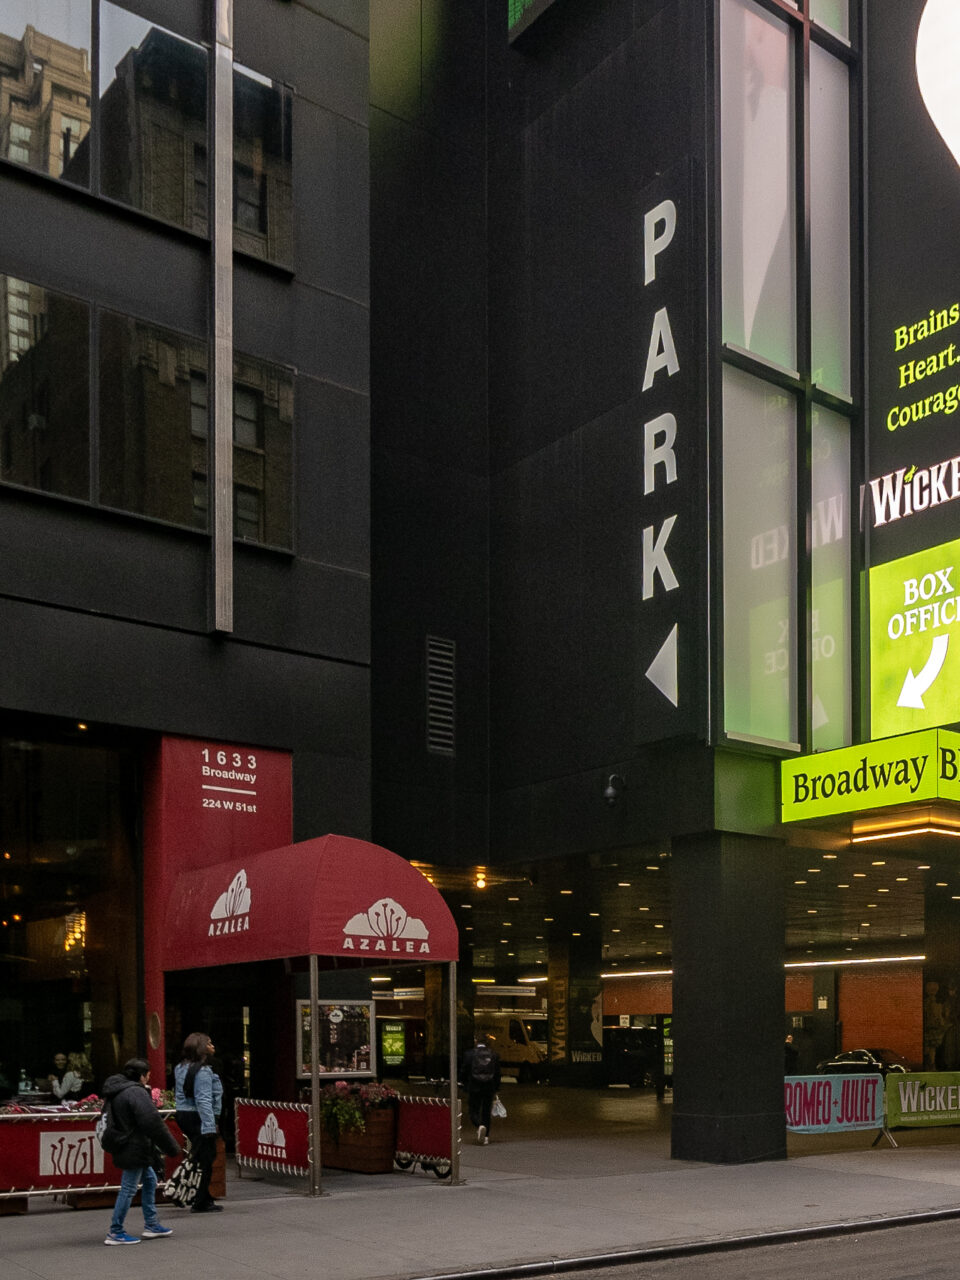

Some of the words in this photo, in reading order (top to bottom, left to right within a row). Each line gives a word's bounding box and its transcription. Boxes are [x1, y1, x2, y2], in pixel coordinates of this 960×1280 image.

[642, 198, 681, 601] PARK
[903, 566, 955, 607] BOX
[202, 748, 257, 769] 1633
[202, 765, 257, 784] Broadway
[792, 755, 929, 804] Broadway
[202, 798, 221, 809] 224
[223, 800, 234, 810] W
[235, 801, 257, 813] 51st
[207, 917, 250, 937] AZALEA
[342, 937, 431, 954] AZALEA
[571, 1050, 602, 1062] WICKED
[784, 1080, 832, 1127] ROMEO
[836, 1079, 878, 1124] JULIET
[257, 1144, 287, 1159] AZALEA
